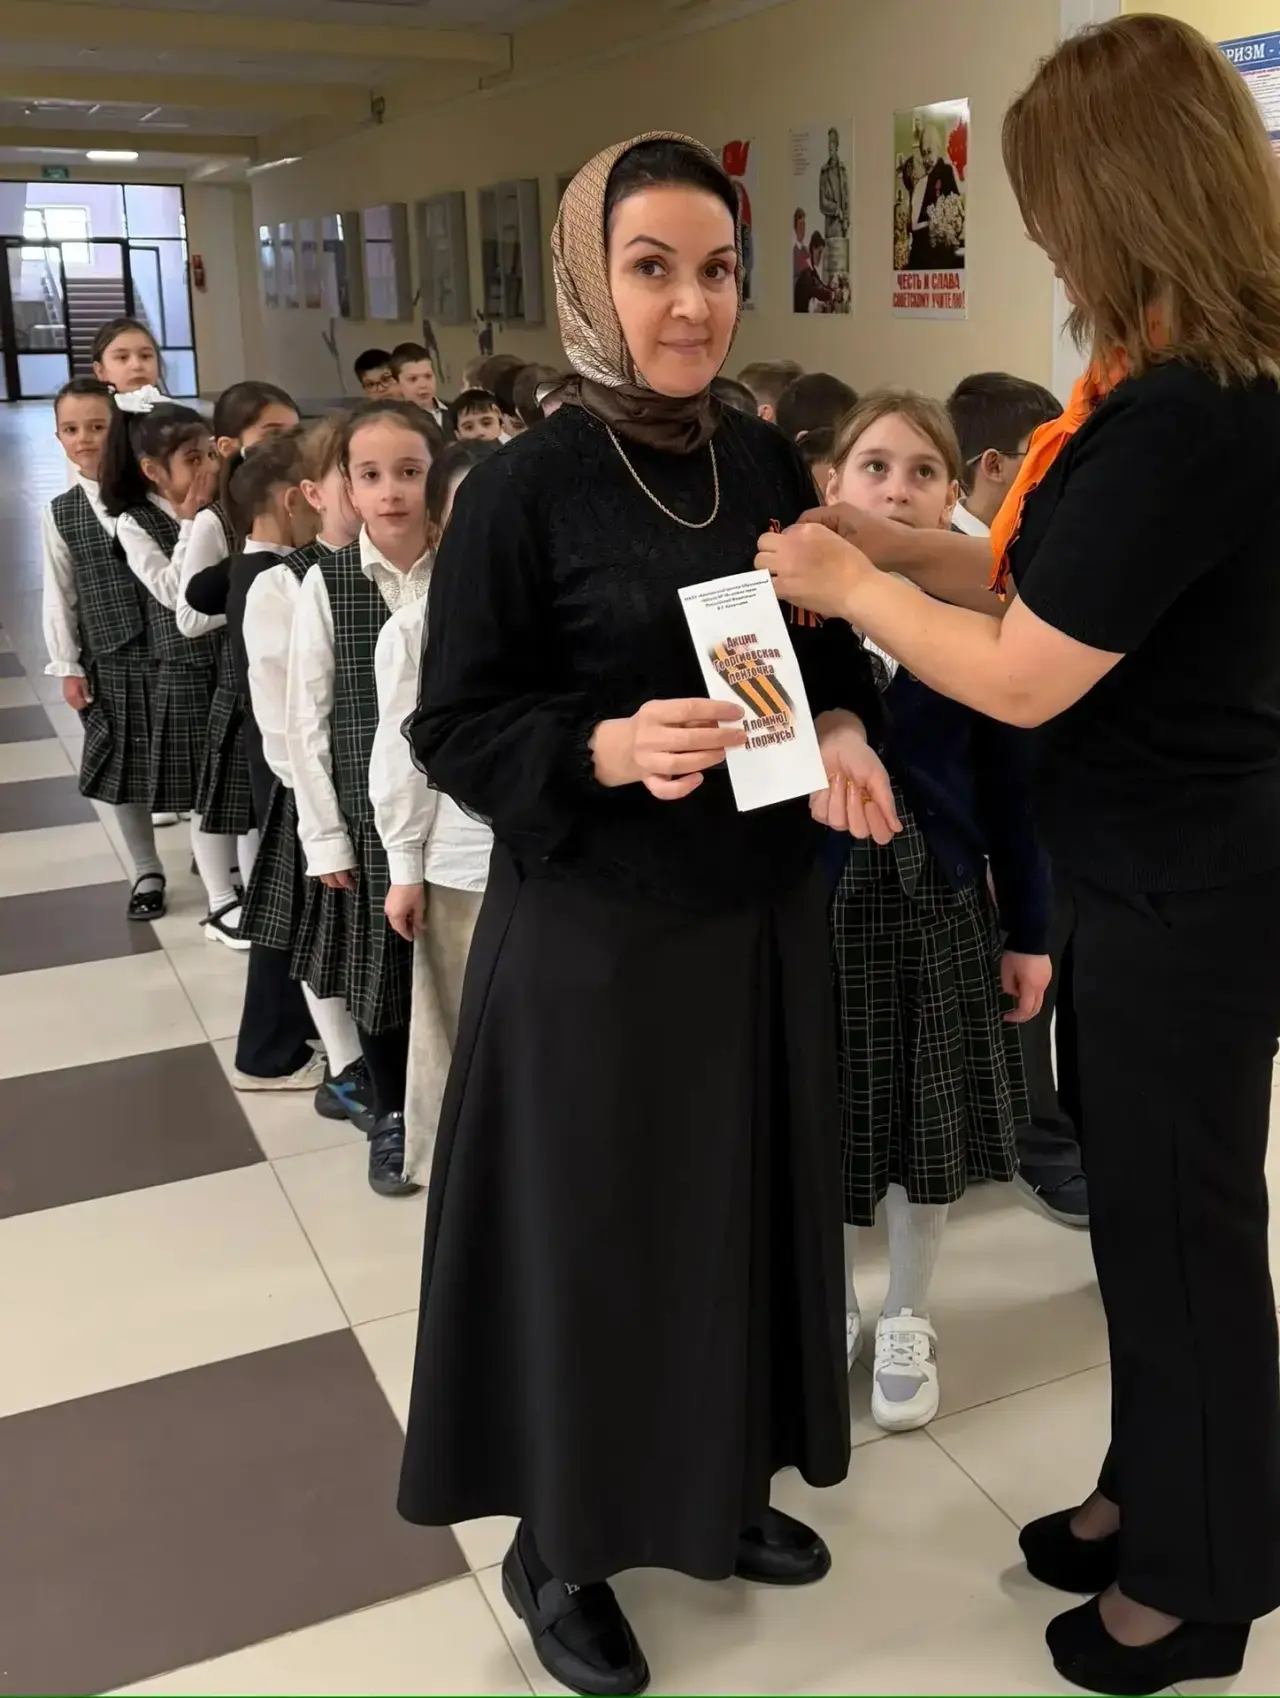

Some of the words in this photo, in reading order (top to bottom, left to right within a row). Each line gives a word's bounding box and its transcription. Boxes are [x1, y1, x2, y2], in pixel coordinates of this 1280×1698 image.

[1222, 43, 1265, 63] РИЗМ
[897, 273, 922, 290] ЧЕСТЬ
[923, 272, 929, 290] И
[931, 272, 960, 290] СЛАВА
[726, 633, 758, 649] Акция
[713, 648, 781, 672] Георгиевская
[728, 664, 775, 684] ленточка
[742, 719, 750, 732] Я
[750, 711, 788, 731] помню!
[751, 726, 796, 750] горжусь!
